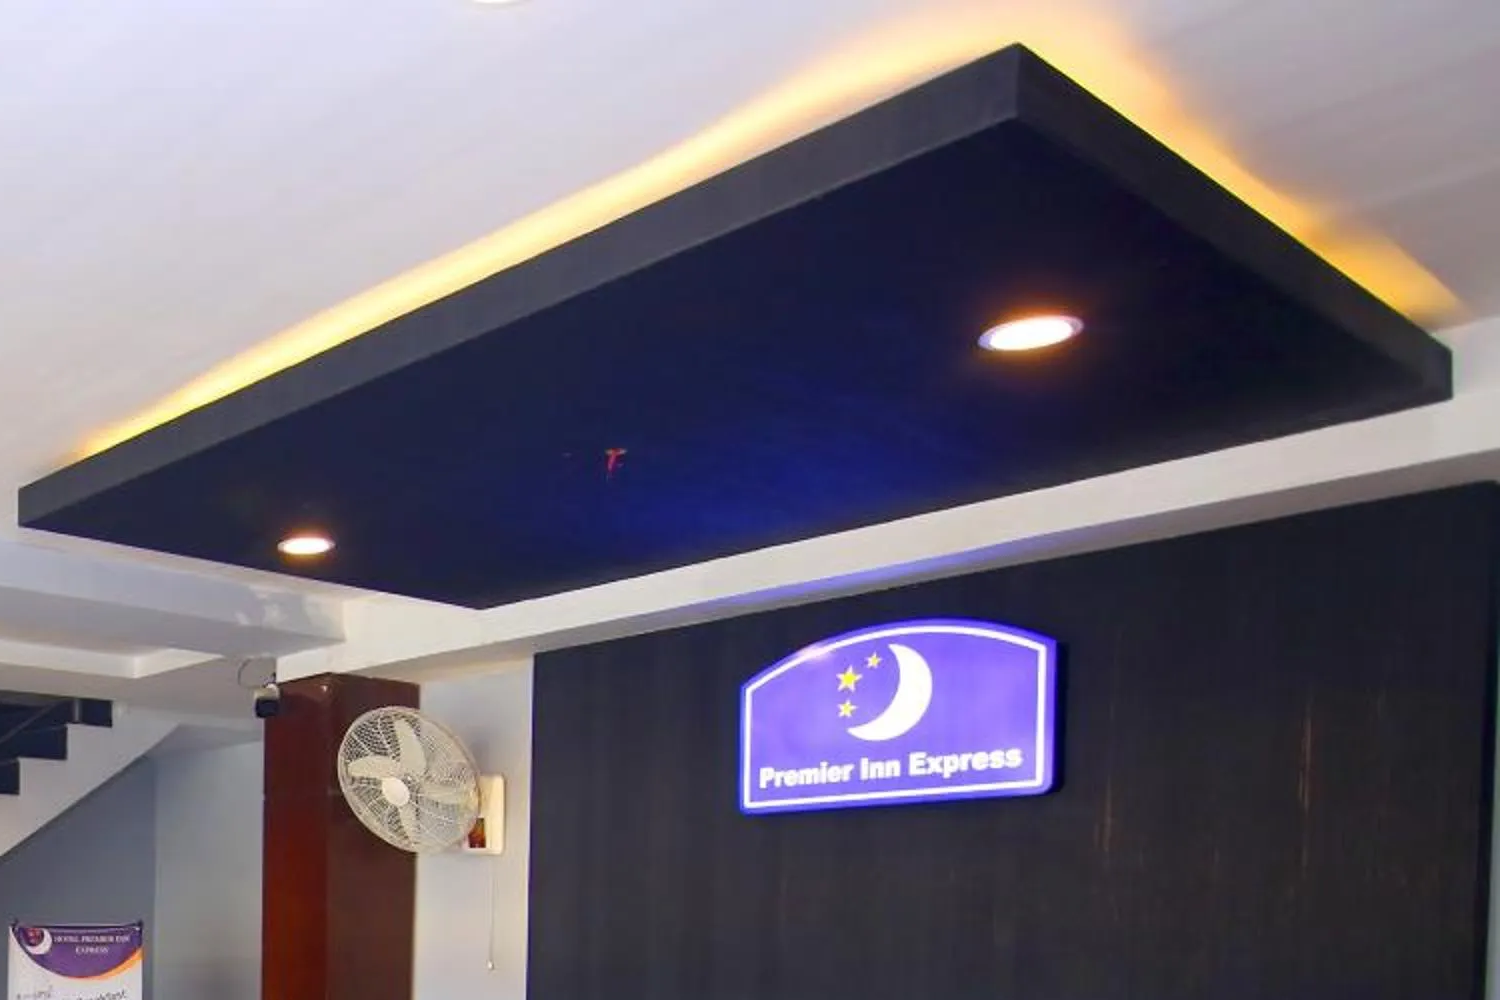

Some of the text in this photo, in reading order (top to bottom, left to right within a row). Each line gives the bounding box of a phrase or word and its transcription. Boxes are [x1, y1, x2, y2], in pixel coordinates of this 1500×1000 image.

[758, 748, 1024, 789] Premier Inn Express
